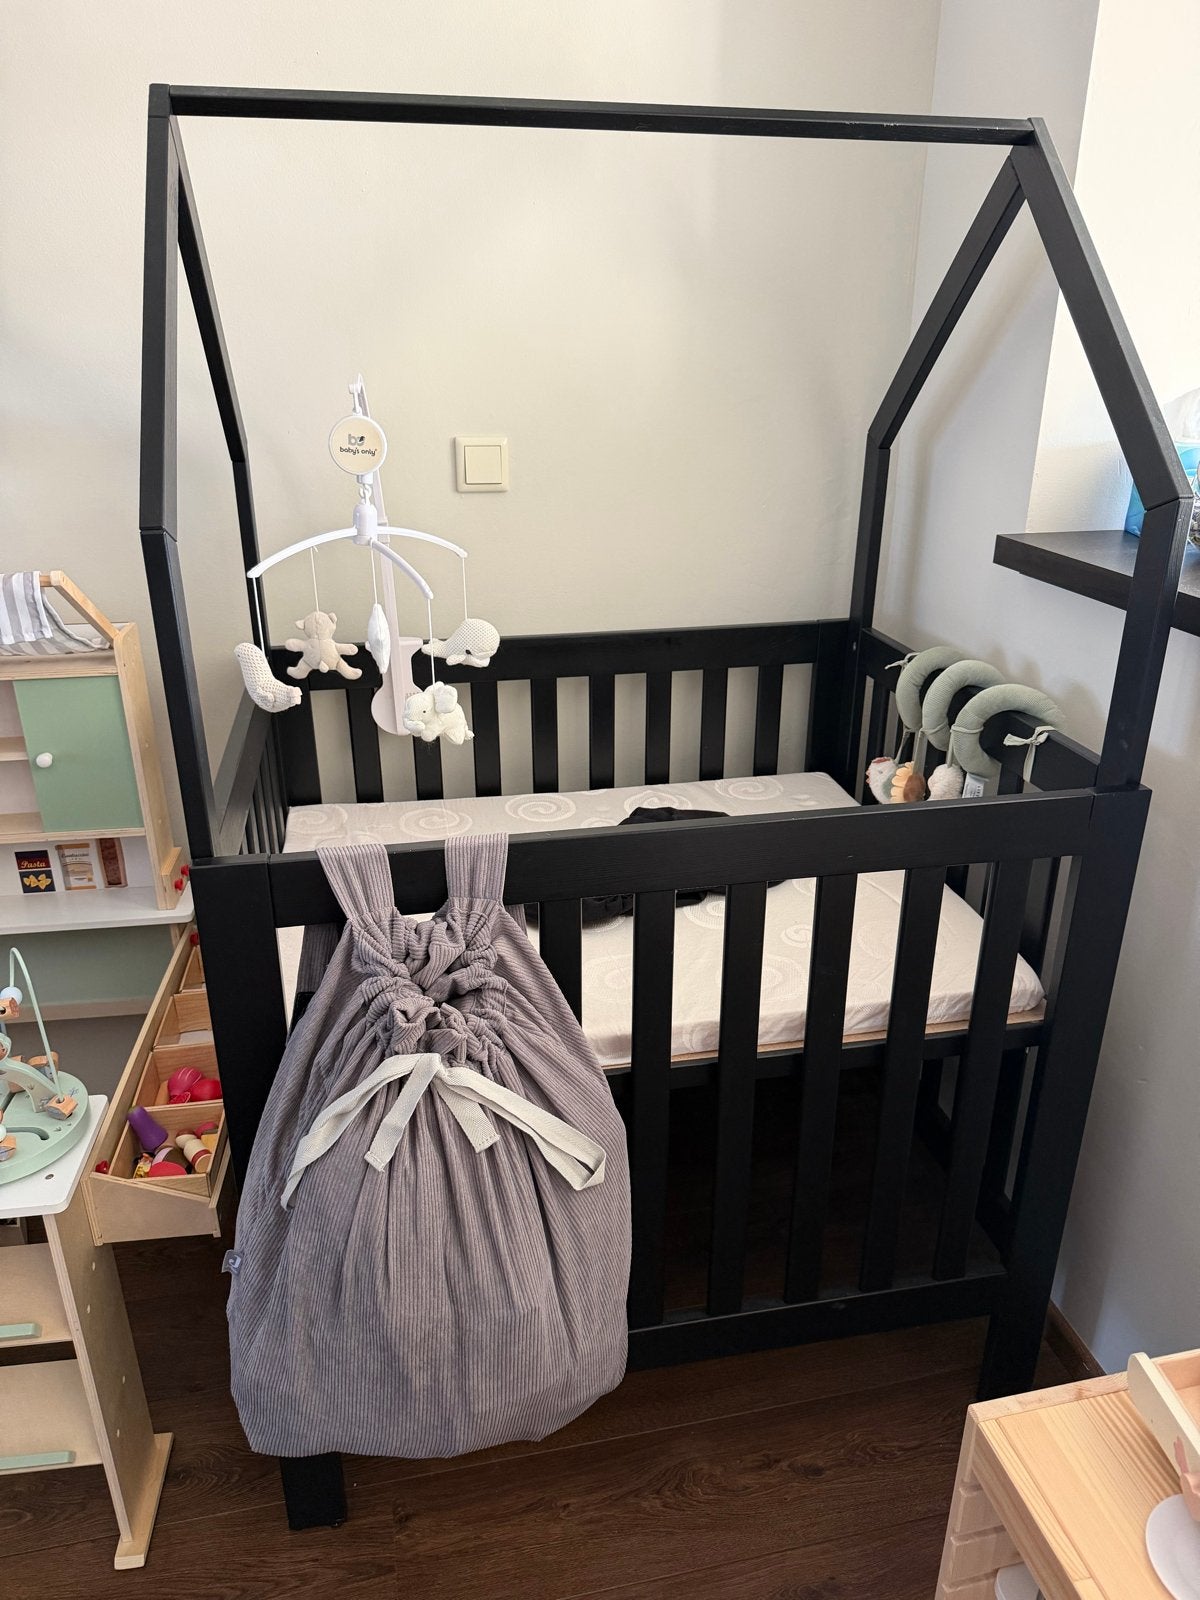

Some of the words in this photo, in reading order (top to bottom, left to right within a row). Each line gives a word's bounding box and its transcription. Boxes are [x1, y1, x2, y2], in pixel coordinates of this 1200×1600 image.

[339, 446, 360, 455] baby's
[360, 448, 376, 457] only
[21, 860, 46, 868] Pasta
